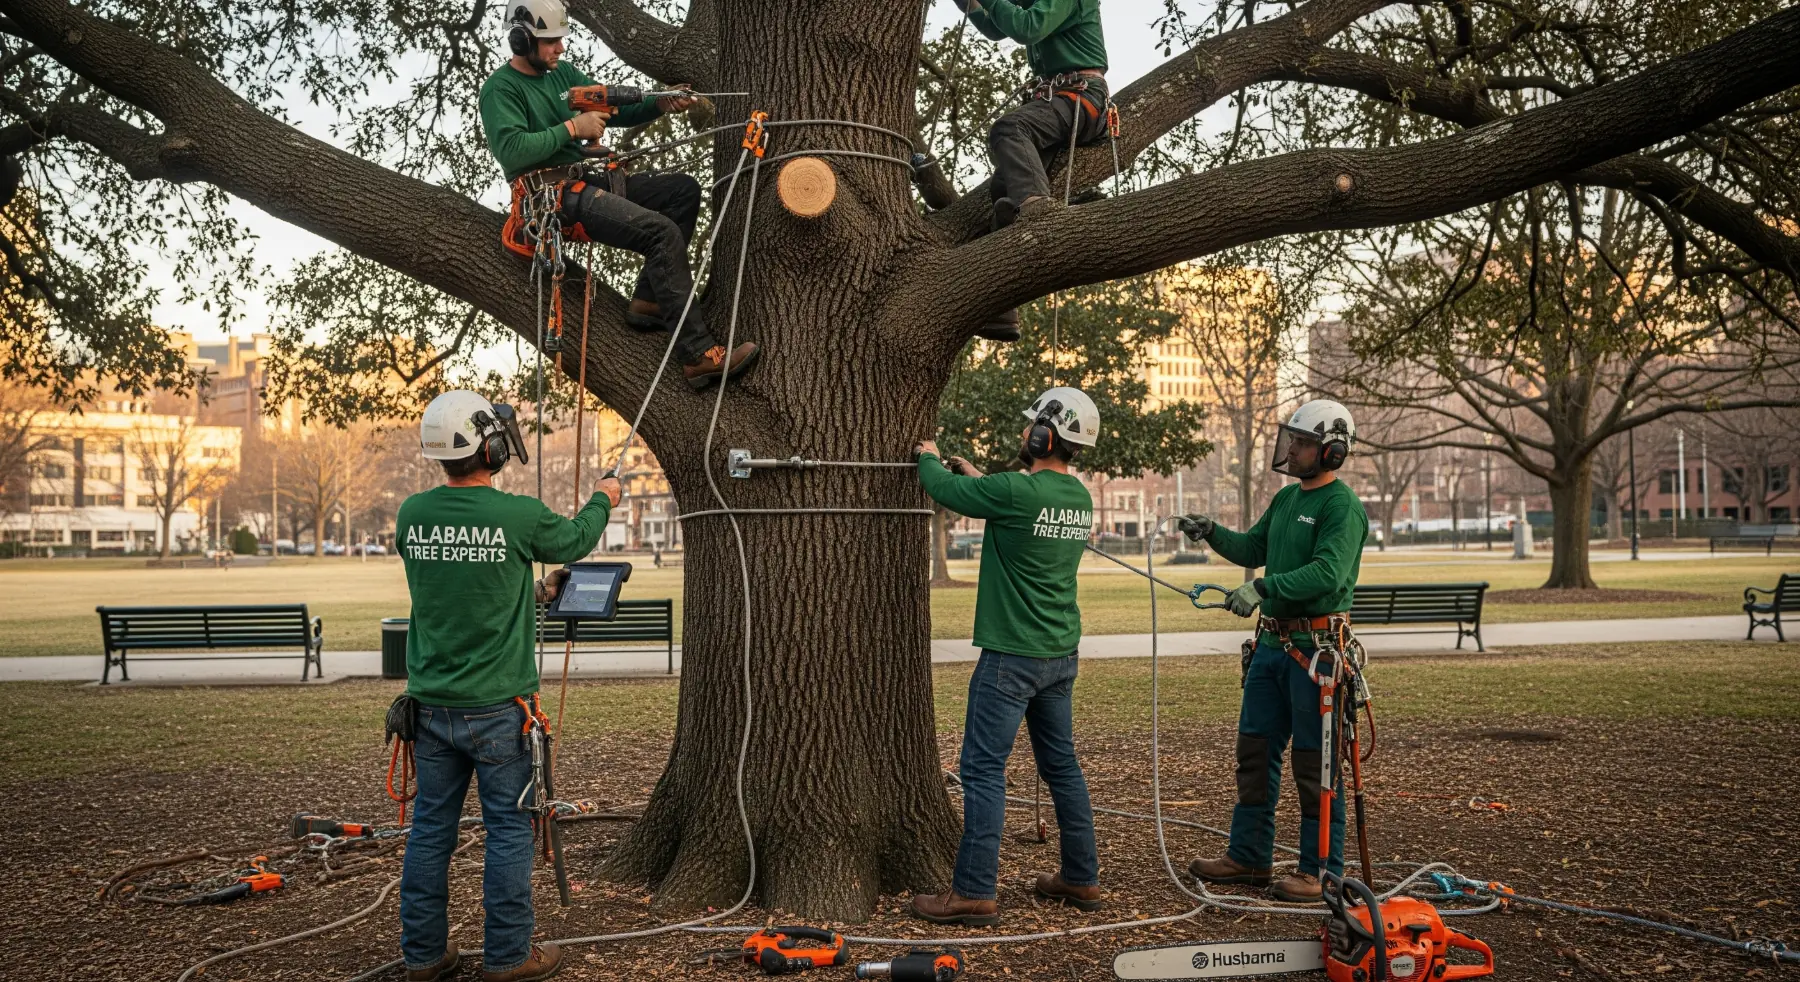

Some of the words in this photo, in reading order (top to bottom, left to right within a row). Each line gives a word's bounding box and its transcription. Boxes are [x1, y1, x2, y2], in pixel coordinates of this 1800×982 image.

[406, 525, 507, 546] ALABAMA
[1033, 523, 1060, 538] TREE
[406, 545, 439, 560] TREE
[442, 546, 507, 562] EXPERTS
